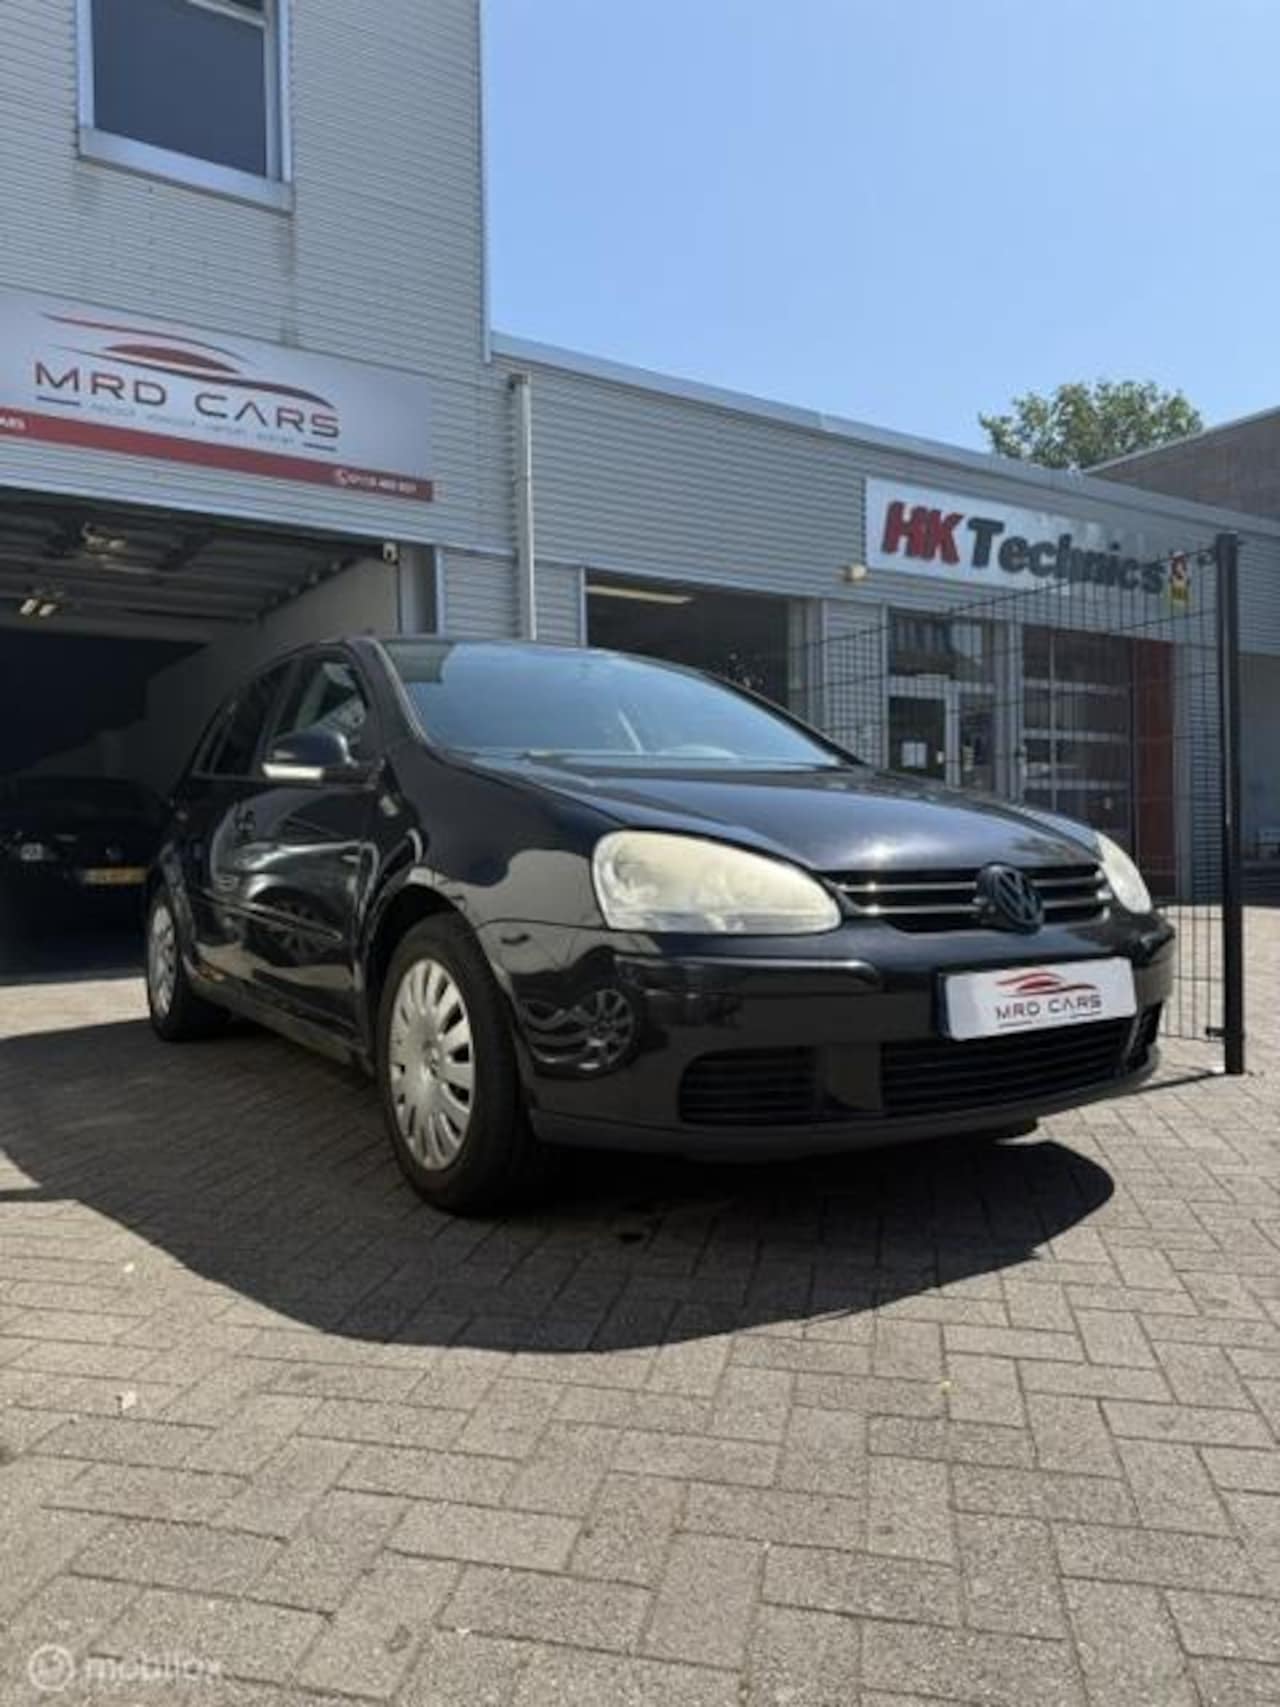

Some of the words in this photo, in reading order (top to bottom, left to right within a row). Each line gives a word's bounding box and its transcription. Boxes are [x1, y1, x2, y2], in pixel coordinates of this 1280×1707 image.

[35, 361, 167, 406] MRD
[195, 393, 340, 439] CARS
[881, 500, 964, 567] HK
[967, 517, 1166, 594] Technics
[995, 1001, 1041, 1019] MRD
[1047, 994, 1103, 1014] CARS
